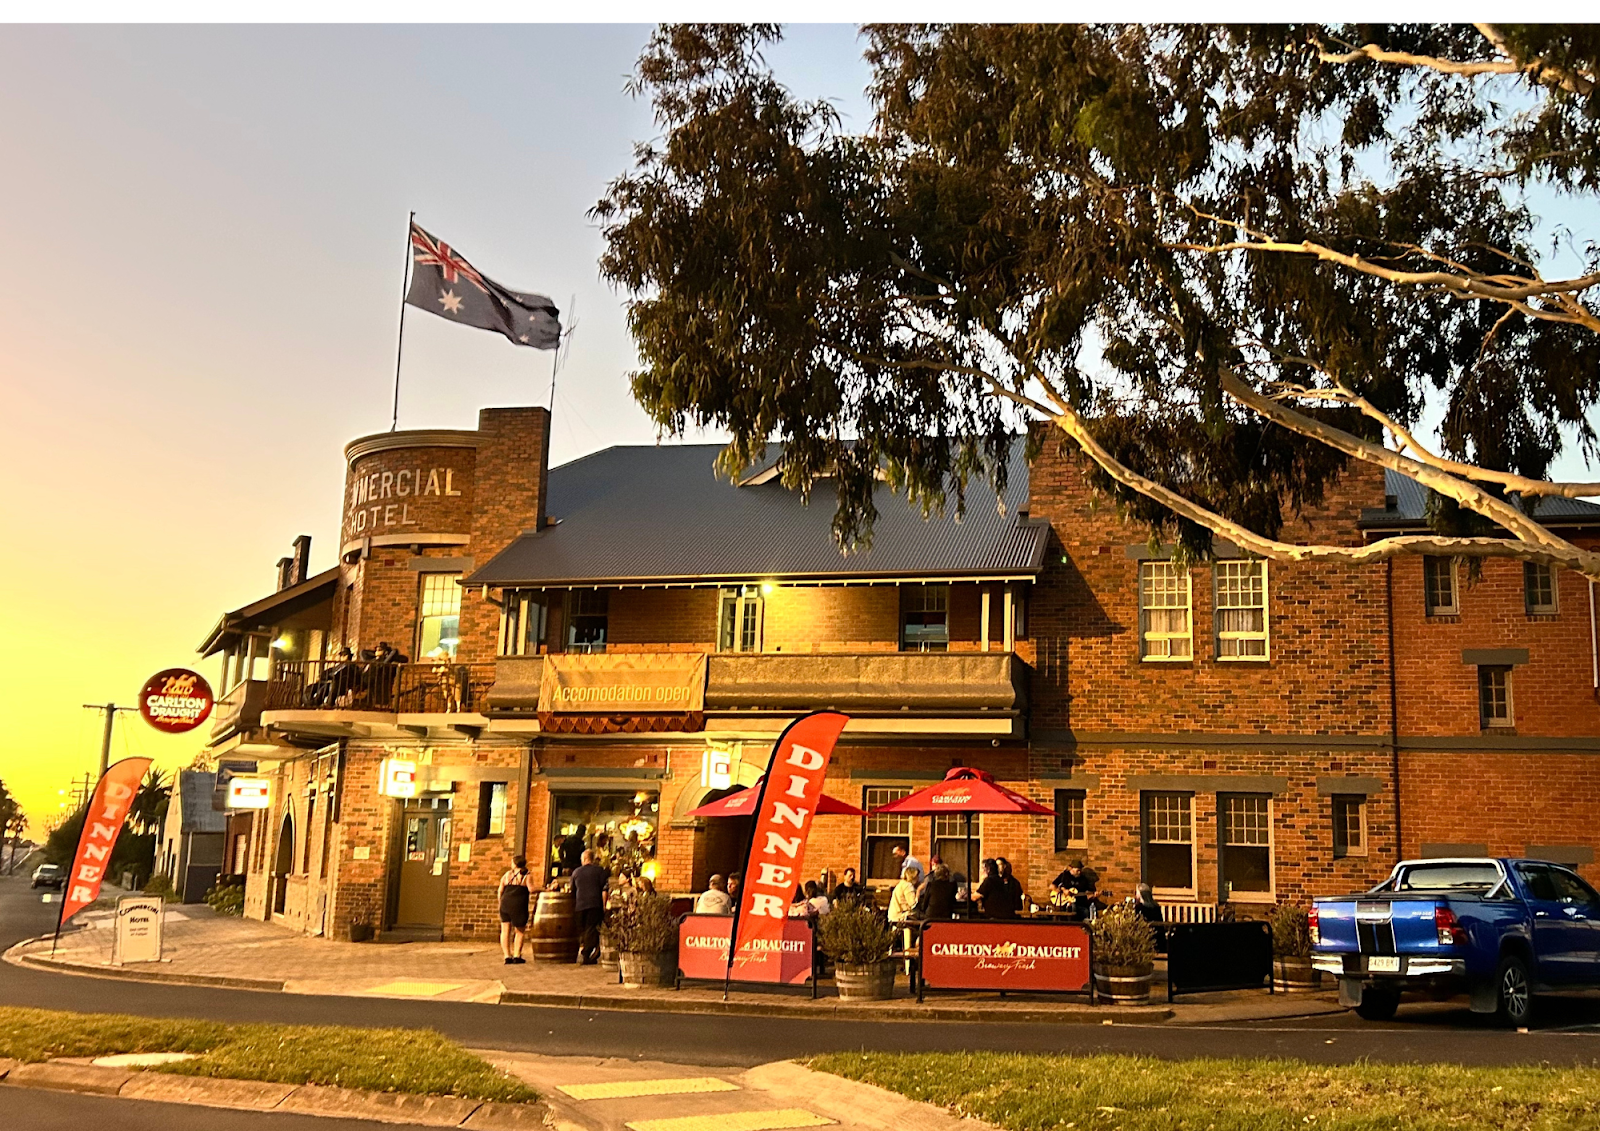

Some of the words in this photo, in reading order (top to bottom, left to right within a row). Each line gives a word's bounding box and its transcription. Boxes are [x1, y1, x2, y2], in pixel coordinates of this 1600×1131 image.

[350, 503, 416, 535] HOTEL
[146, 694, 206, 710] CARLTON
[553, 684, 652, 702] Accomodation
[656, 685, 690, 703] open
[149, 706, 201, 718] DRAUGHT
[749, 743, 824, 919] DINNER
[70, 782, 132, 903] DINNER
[752, 938, 805, 952] DRAUGHT
[931, 943, 993, 956] CARLTON
[1017, 945, 1081, 958] DRAUGHT
[974, 957, 1012, 976] Brewery
[1012, 958, 1036, 970] Fresh
